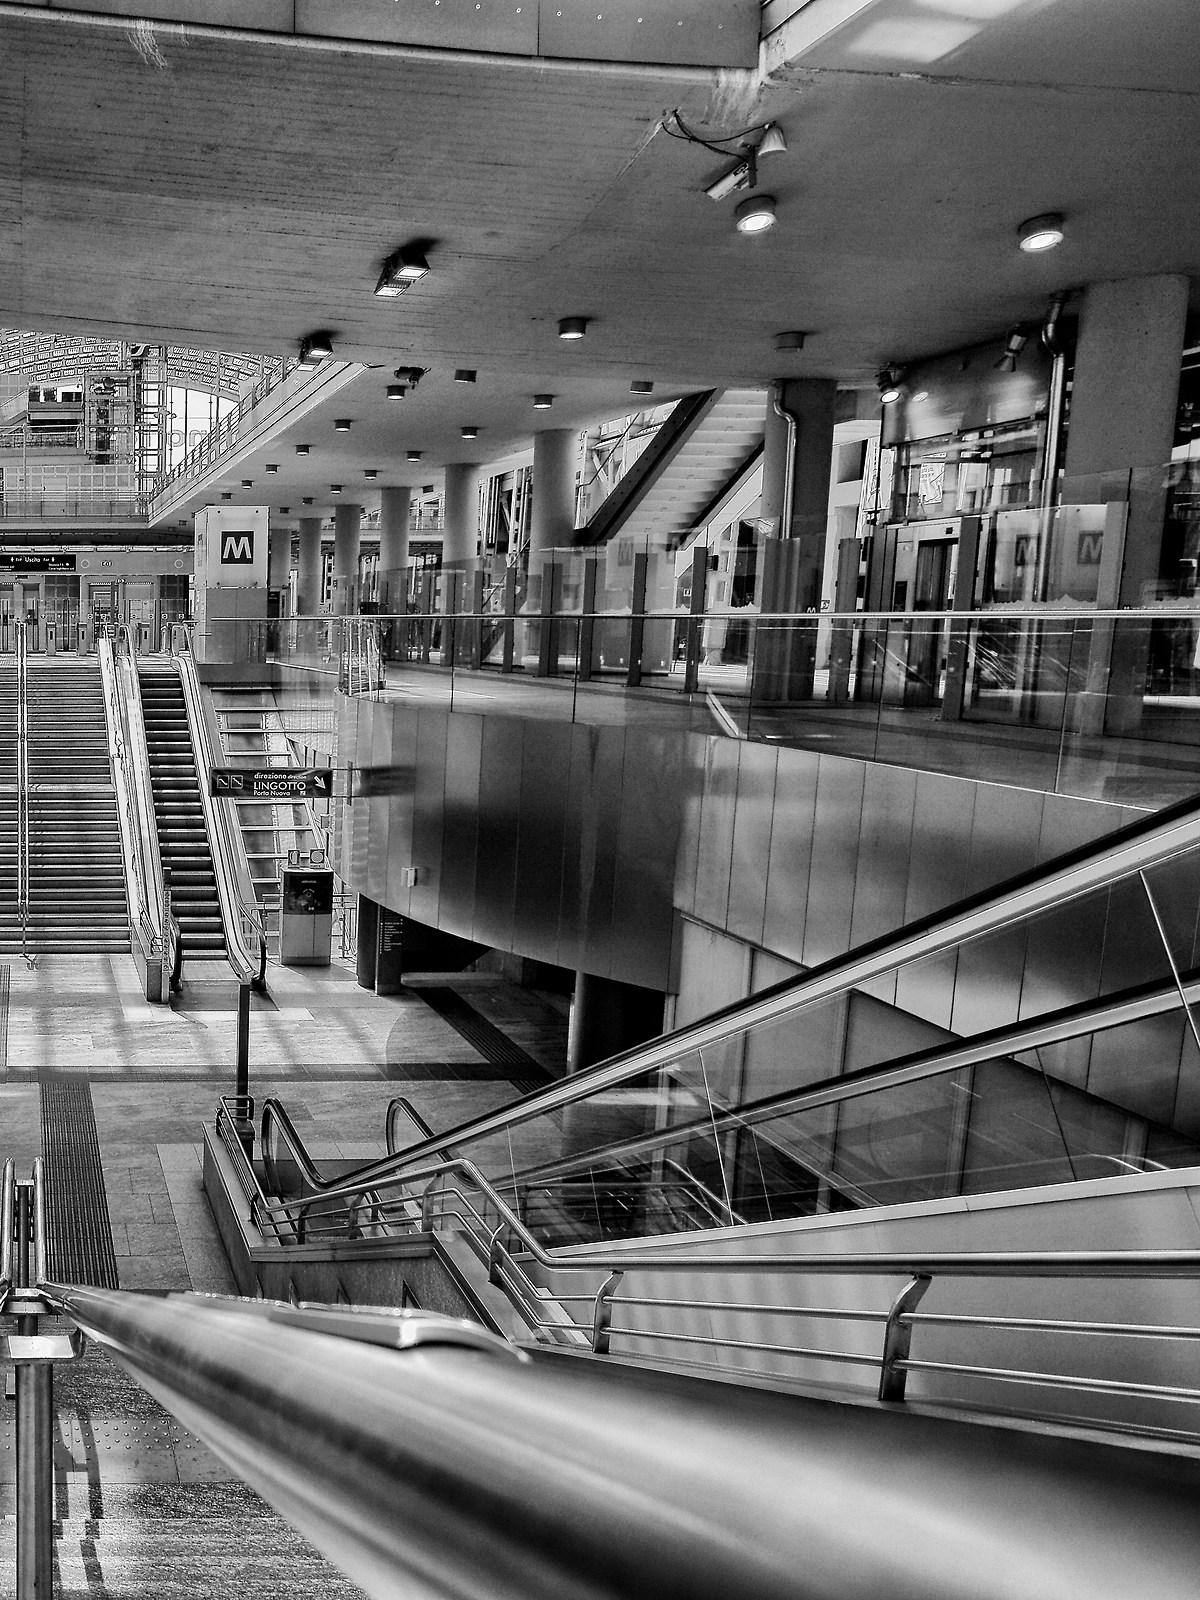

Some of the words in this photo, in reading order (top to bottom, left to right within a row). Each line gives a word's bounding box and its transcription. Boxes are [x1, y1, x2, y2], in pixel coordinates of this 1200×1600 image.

[222, 536, 252, 559] M
[254, 772, 287, 780] direzione
[253, 781, 307, 791] LINGOTTO
